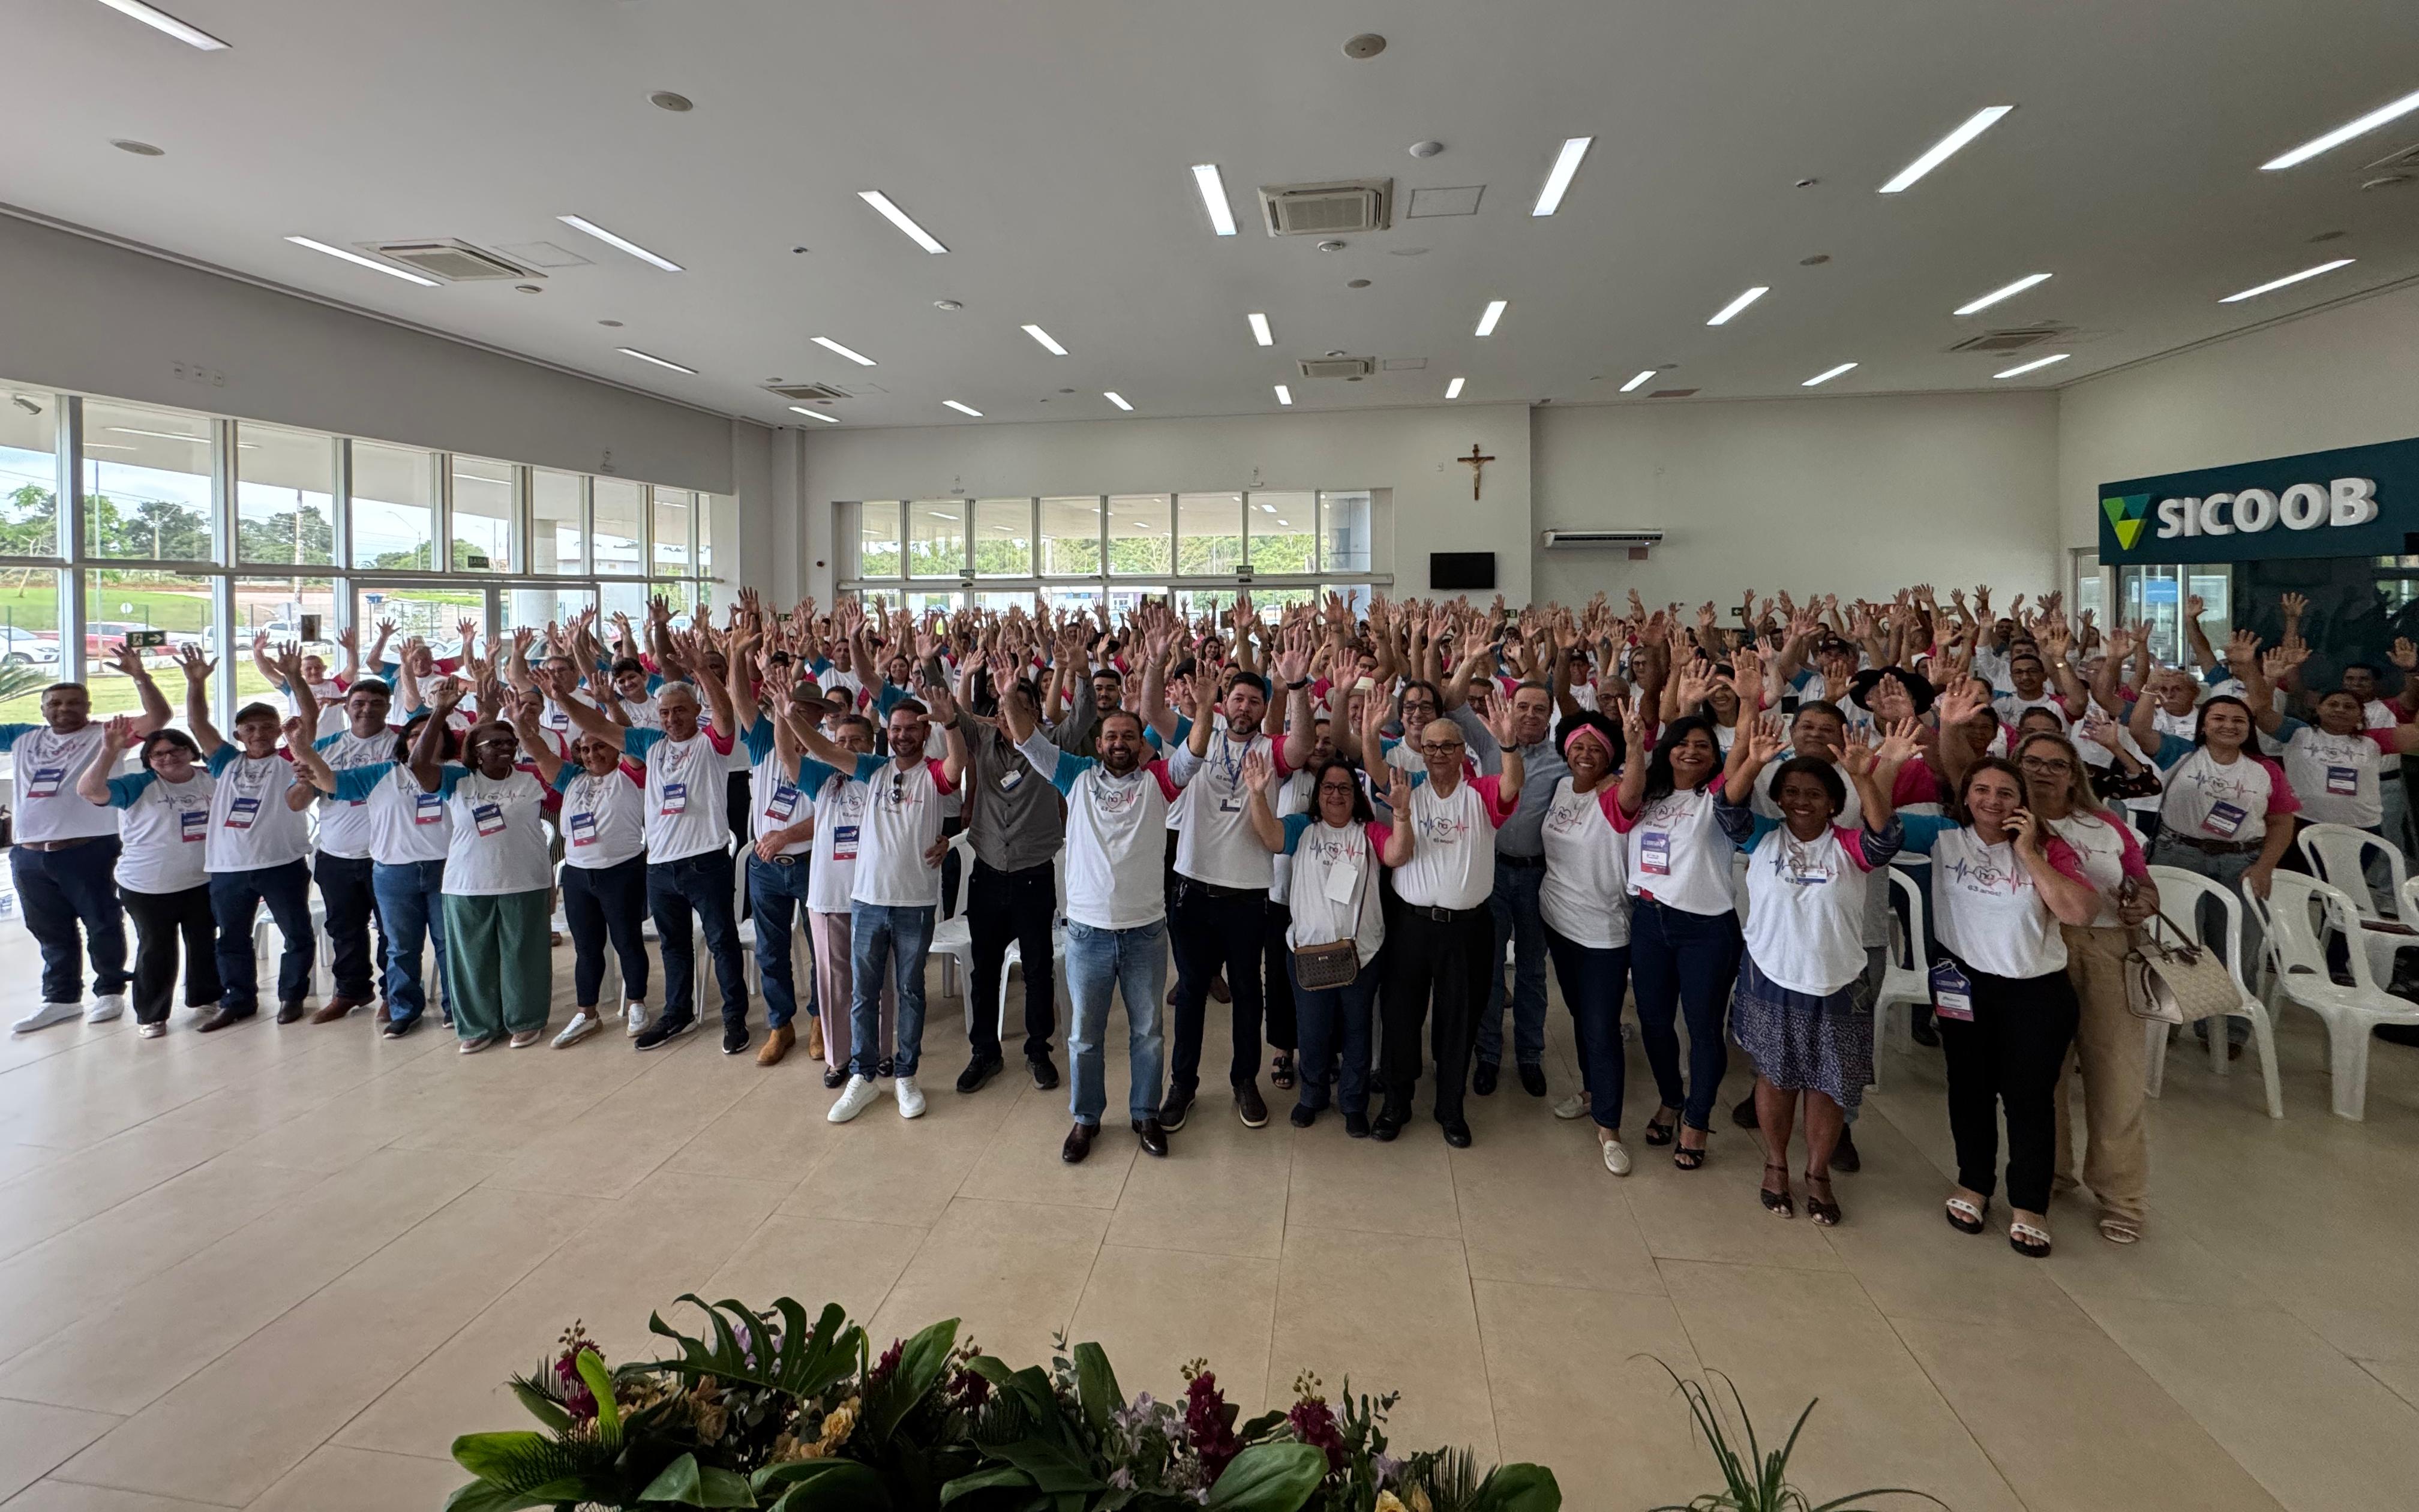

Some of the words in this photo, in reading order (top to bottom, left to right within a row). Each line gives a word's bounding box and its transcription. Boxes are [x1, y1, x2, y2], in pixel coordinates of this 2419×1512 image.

[2157, 477, 2379, 539] SICOOB
[1438, 820, 1448, 829] ha
[1979, 870, 1995, 880] ha
[1980, 888, 2001, 897] anos!
